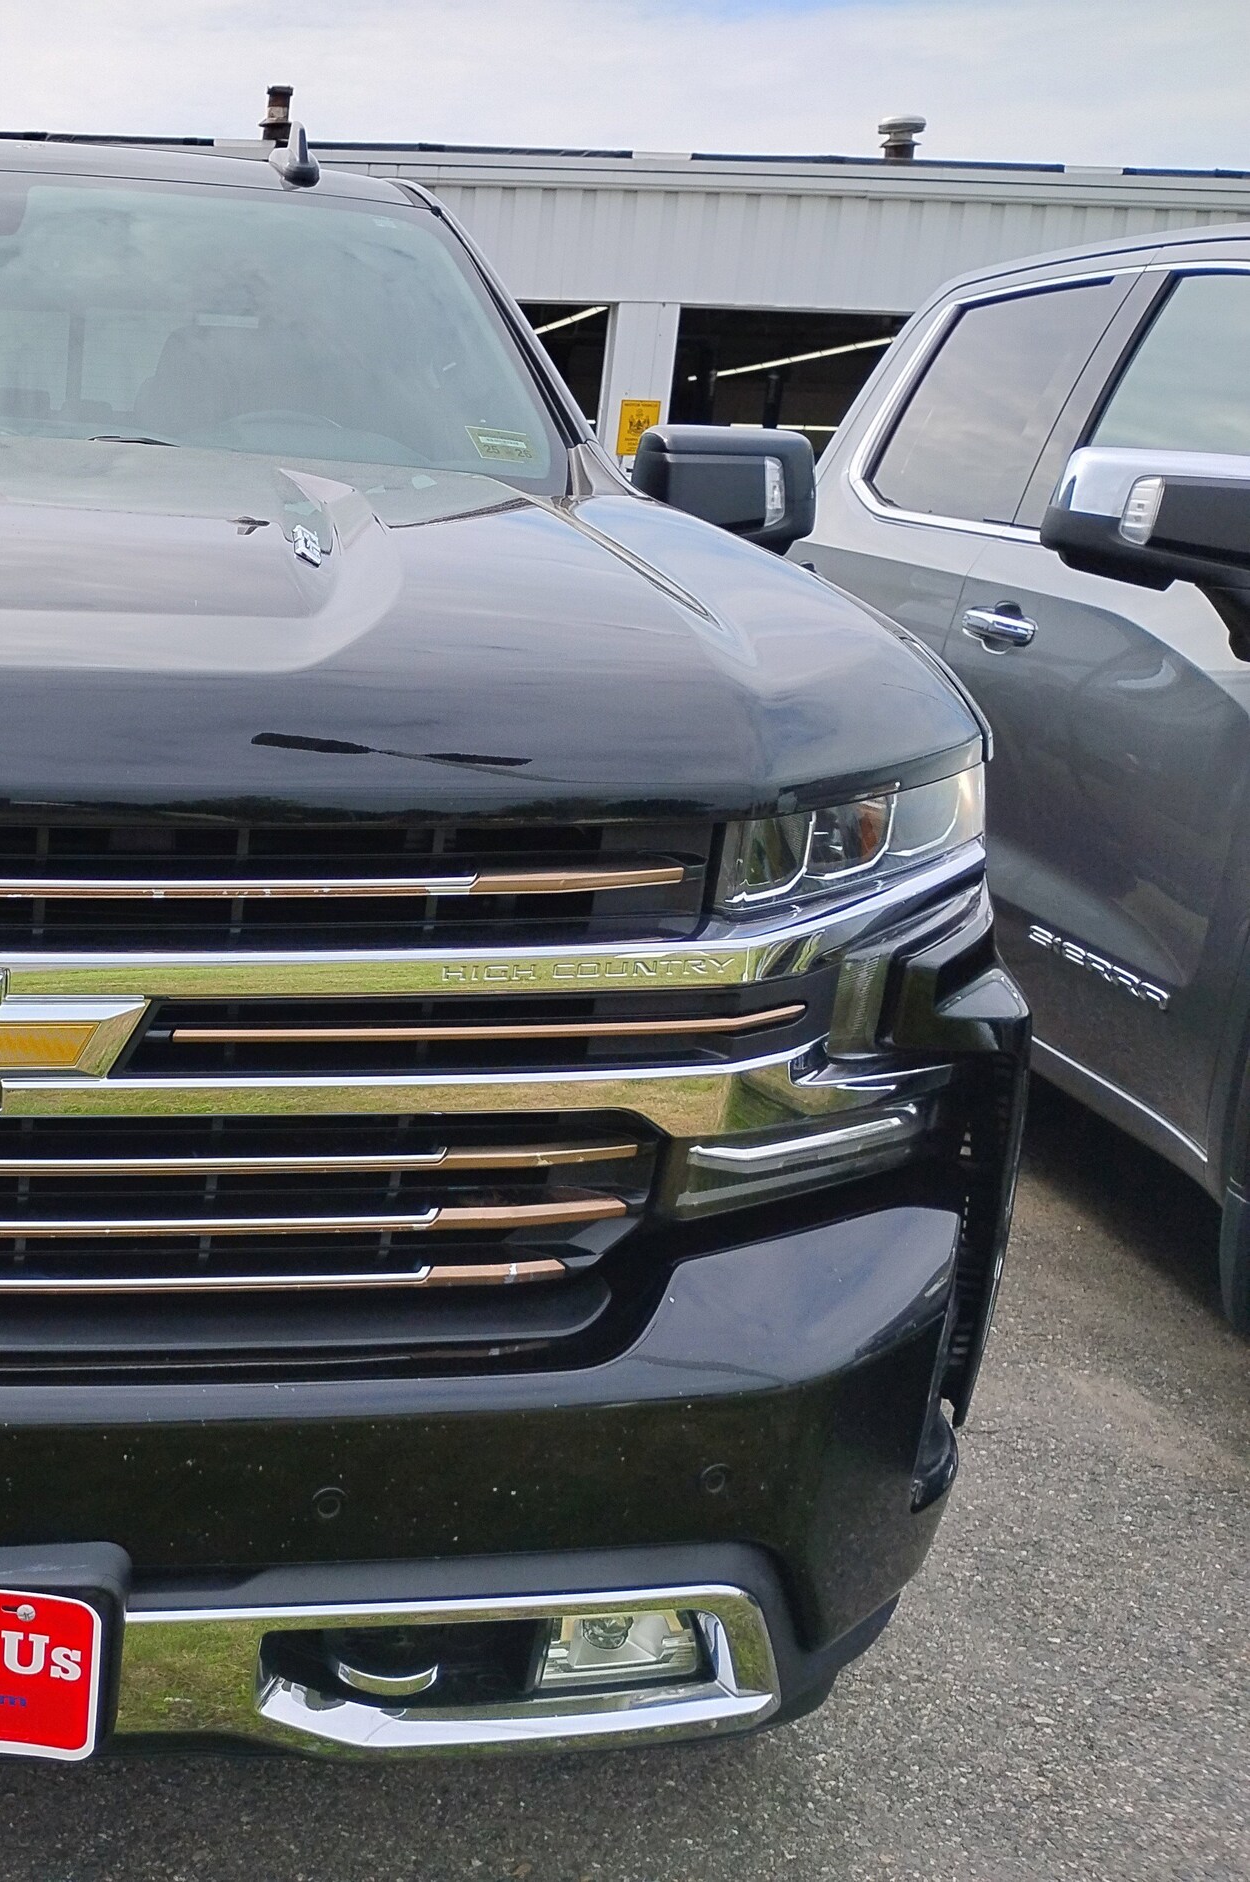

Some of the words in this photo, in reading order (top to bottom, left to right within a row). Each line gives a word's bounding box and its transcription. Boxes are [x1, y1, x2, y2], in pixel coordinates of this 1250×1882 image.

[483, 444, 500, 454] 25
[441, 962, 537, 982] HIGH
[551, 958, 735, 979] COUNTRY
[1028, 924, 1171, 1010] SIERRA
[0, 1629, 82, 1681] Us
